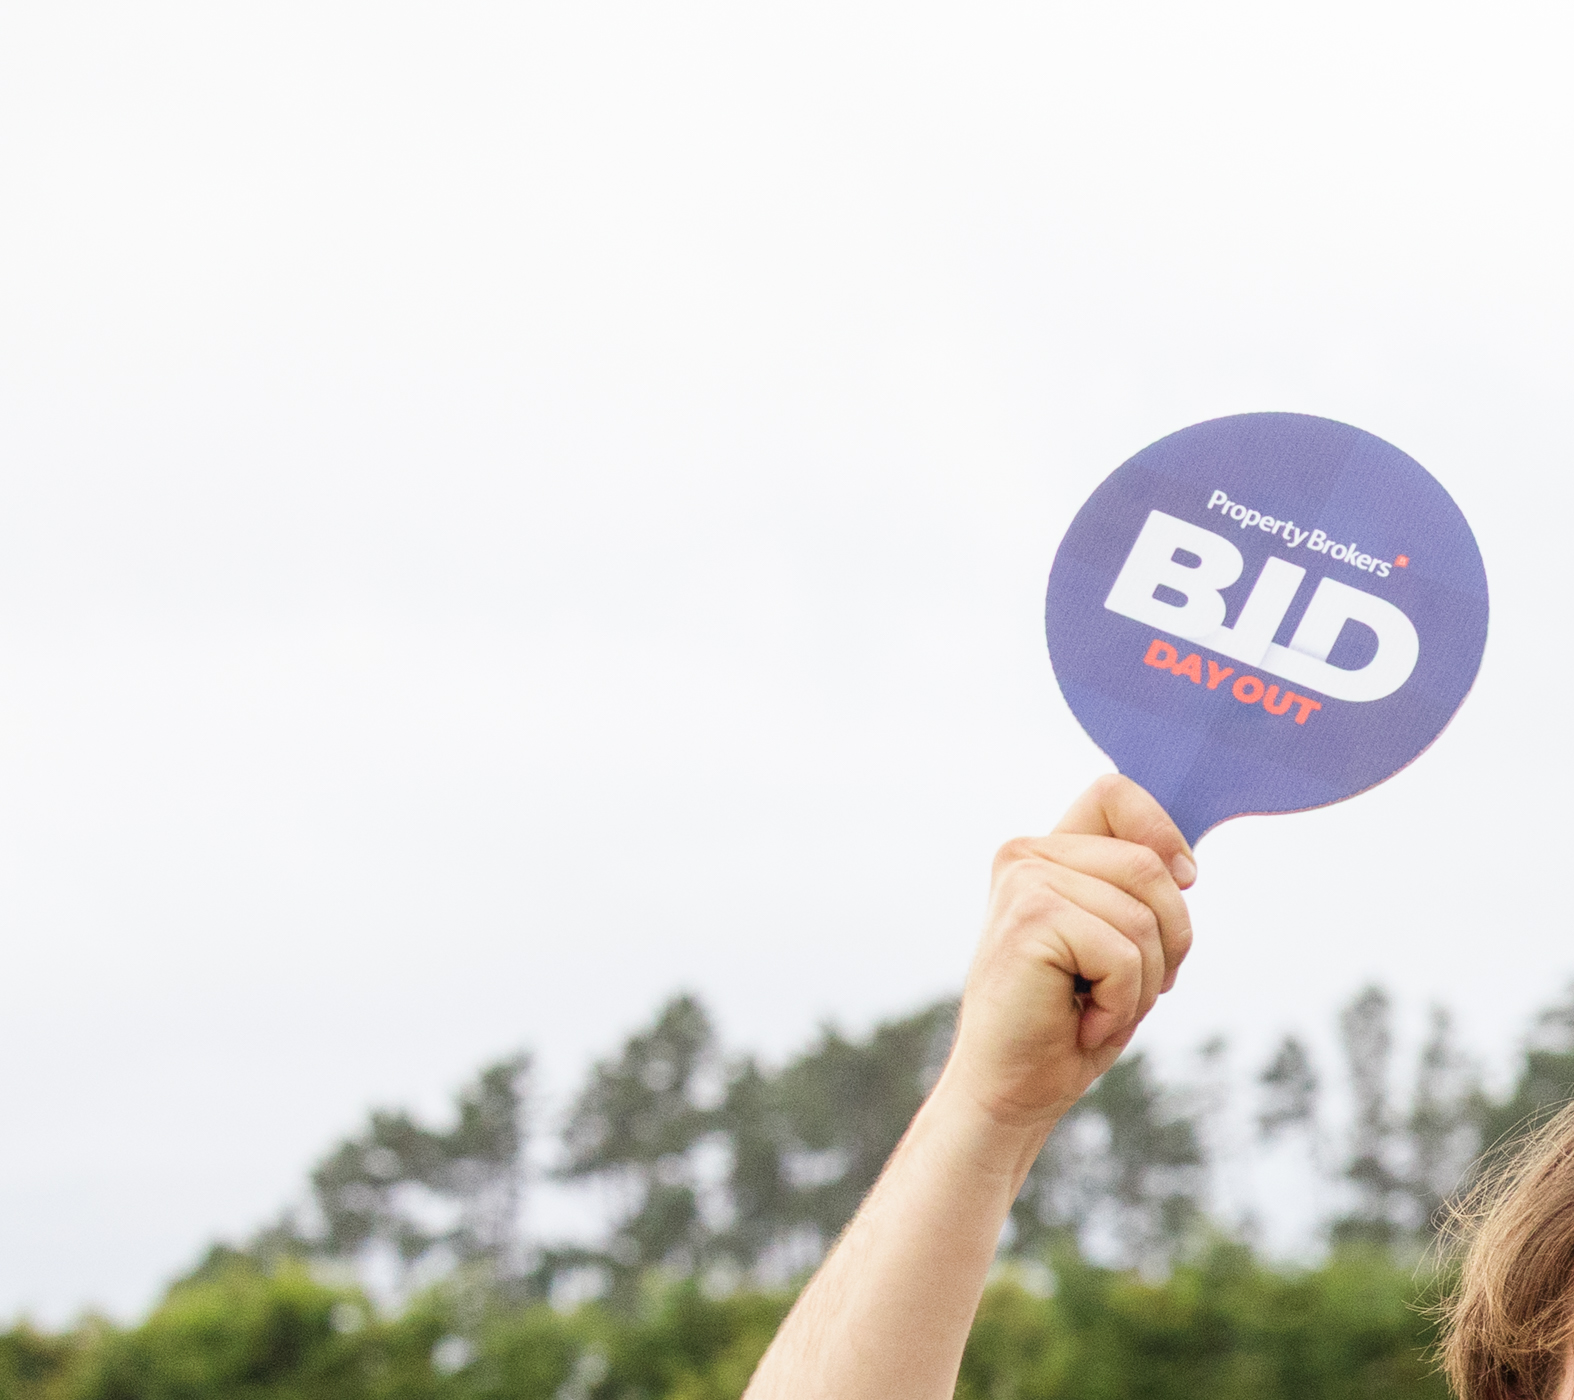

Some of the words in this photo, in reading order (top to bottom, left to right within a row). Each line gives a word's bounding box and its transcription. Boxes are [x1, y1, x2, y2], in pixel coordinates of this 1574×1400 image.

[1207, 489, 1309, 548] Property
[1306, 528, 1393, 578] Brokers
[1104, 509, 1419, 702] BID
[1142, 638, 1234, 692] DAY
[1230, 674, 1322, 726] OUT
